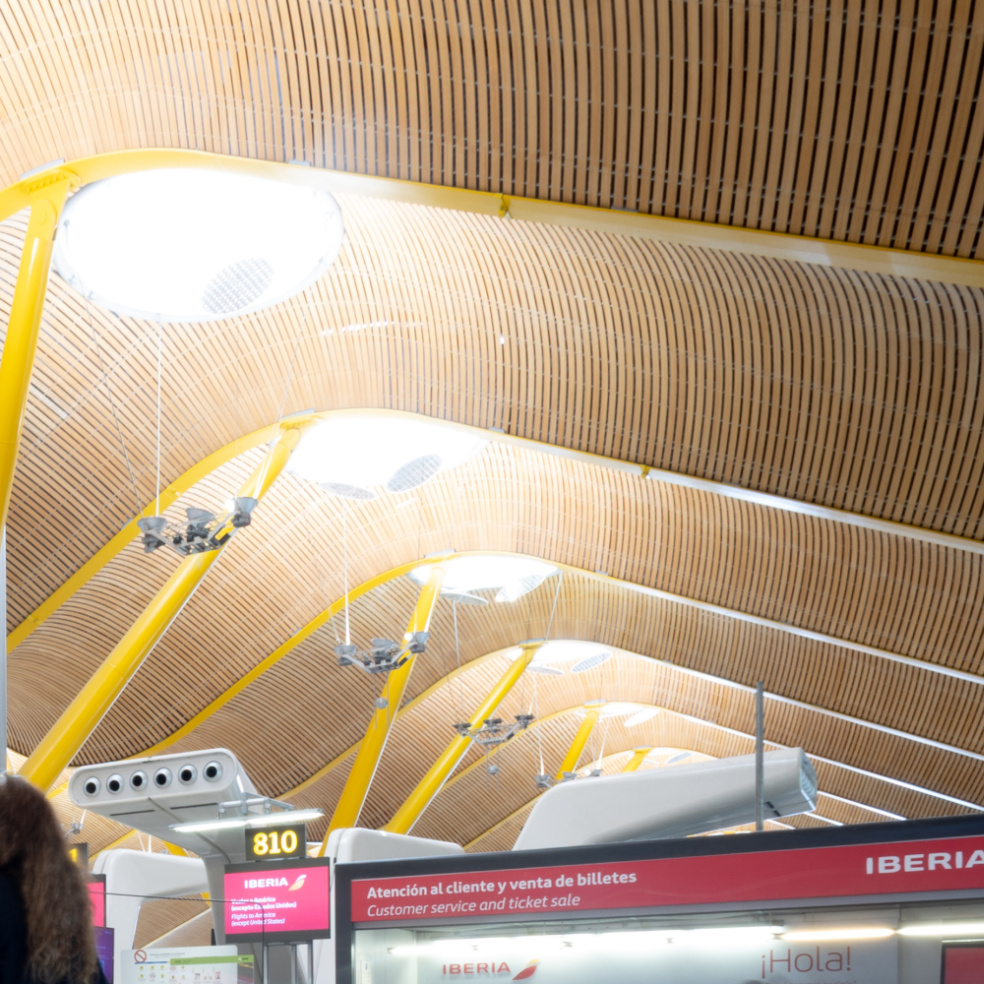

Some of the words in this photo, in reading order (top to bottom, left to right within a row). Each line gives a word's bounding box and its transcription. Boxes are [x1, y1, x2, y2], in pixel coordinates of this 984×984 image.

[253, 829, 298, 856] 810
[866, 849, 984, 875] IBERIA
[244, 877, 289, 889] IBERIA
[367, 883, 428, 899] Atención
[430, 882, 443, 895] al
[446, 880, 495, 894] cliente
[497, 881, 507, 894] y
[509, 877, 552, 890] venta
[555, 874, 574, 887] de
[577, 872, 637, 886] billetes
[367, 904, 428, 917] Customer
[430, 900, 476, 914] service
[479, 897, 506, 911] and
[508, 895, 548, 909] ticket
[551, 893, 581, 907] sale
[442, 961, 511, 975] IBERIA
[761, 945, 851, 979] ¡Hola!
